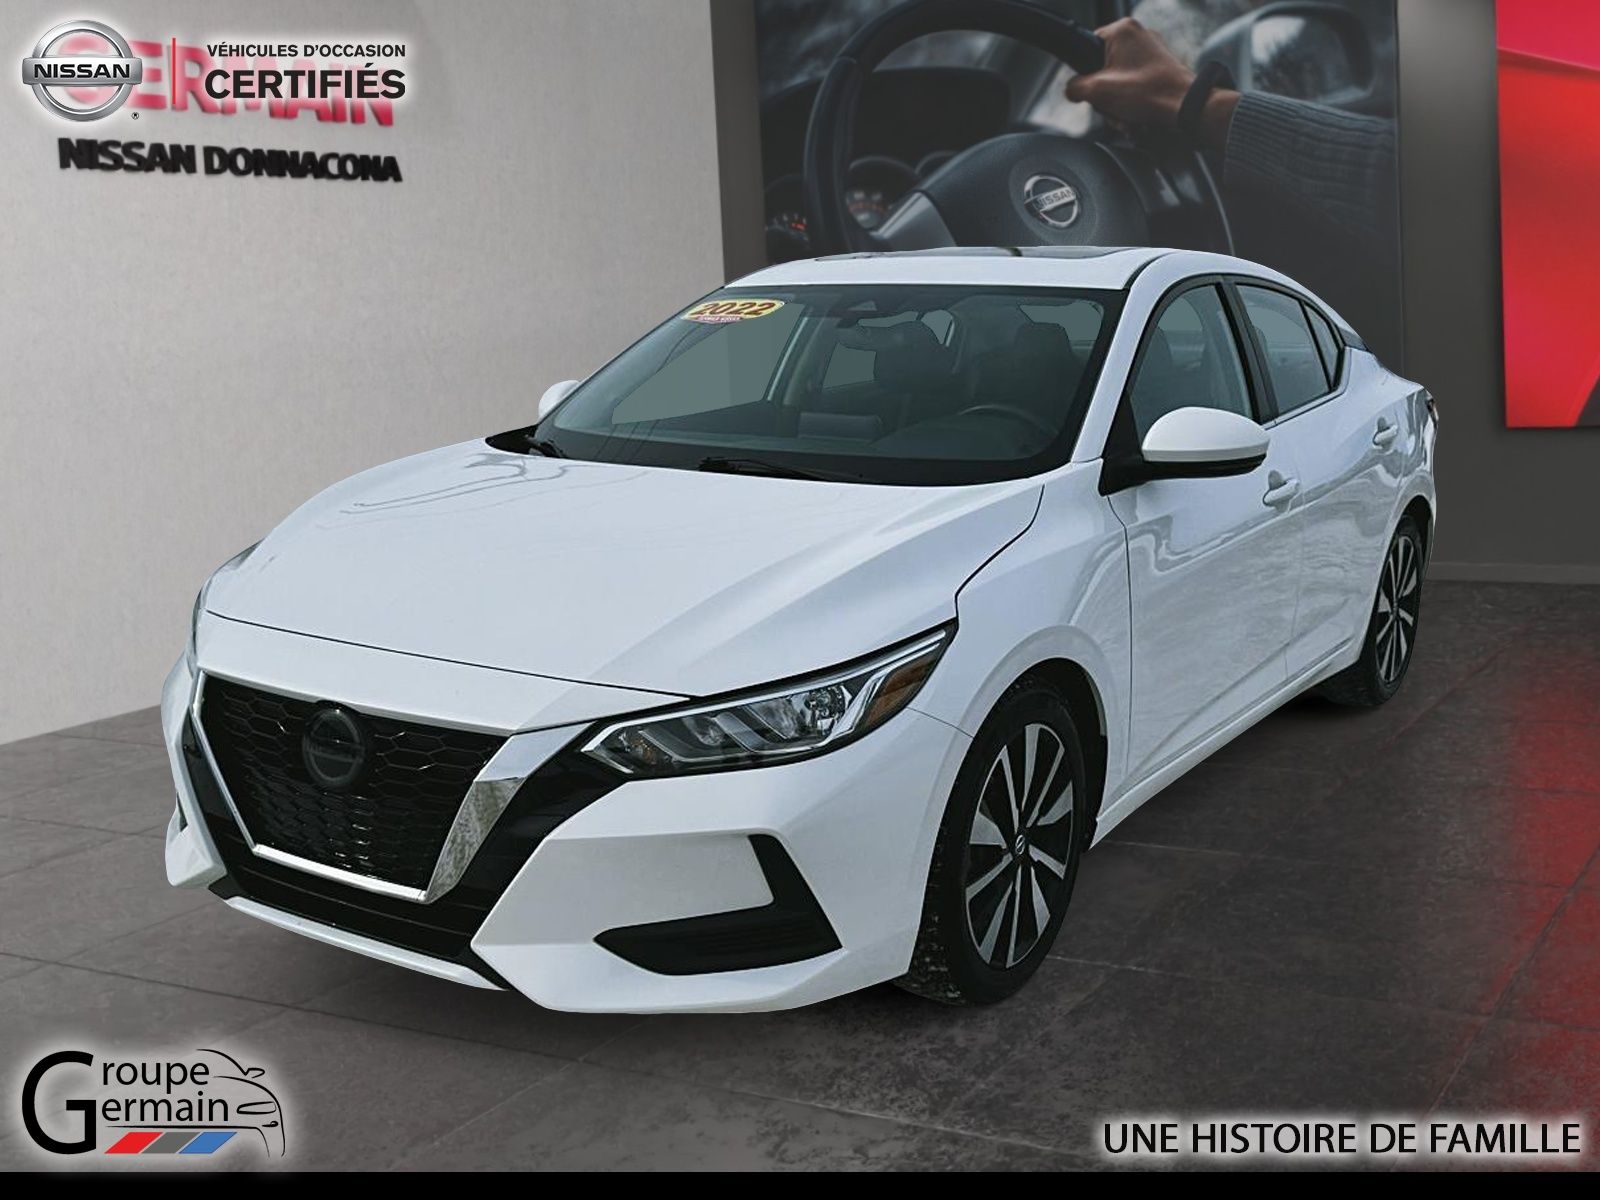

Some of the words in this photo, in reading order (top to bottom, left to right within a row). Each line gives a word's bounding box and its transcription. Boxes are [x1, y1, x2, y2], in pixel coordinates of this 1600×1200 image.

[58, 137, 196, 174] NISSAN
[203, 145, 403, 182] DONNACONA
[1033, 189, 1074, 208] NISSAN
[689, 302, 776, 316] 2022
